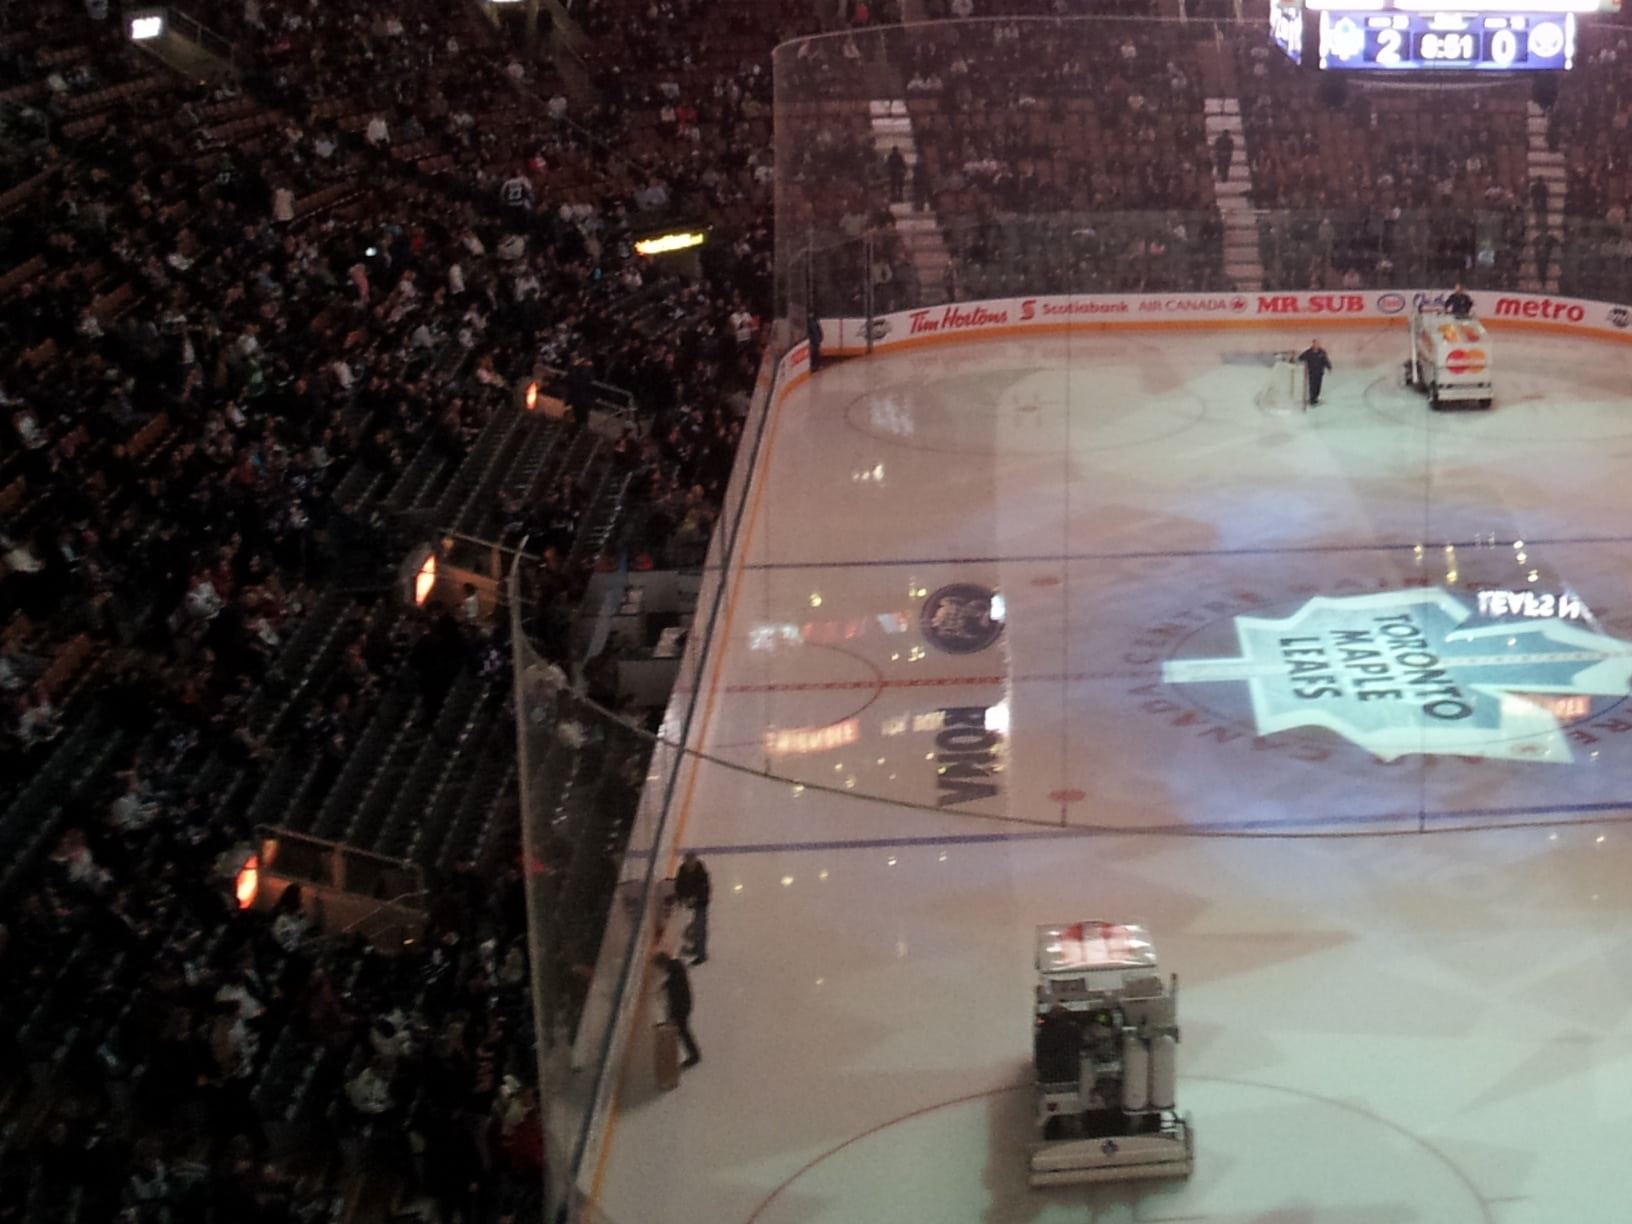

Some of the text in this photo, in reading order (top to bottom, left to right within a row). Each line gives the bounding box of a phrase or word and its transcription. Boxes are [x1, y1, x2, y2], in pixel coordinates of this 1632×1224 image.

[1377, 28, 1402, 63] 2
[1491, 29, 1517, 63] 0
[1042, 301, 1129, 316] Scotiabank
[1138, 299, 1227, 312] AIR CANADA
[1494, 296, 1586, 323] metro
[909, 310, 939, 334] Tim
[1279, 635, 1342, 701] LEAFS
[1330, 628, 1404, 703] MAPLE
[1372, 612, 1473, 721] TORONTO
